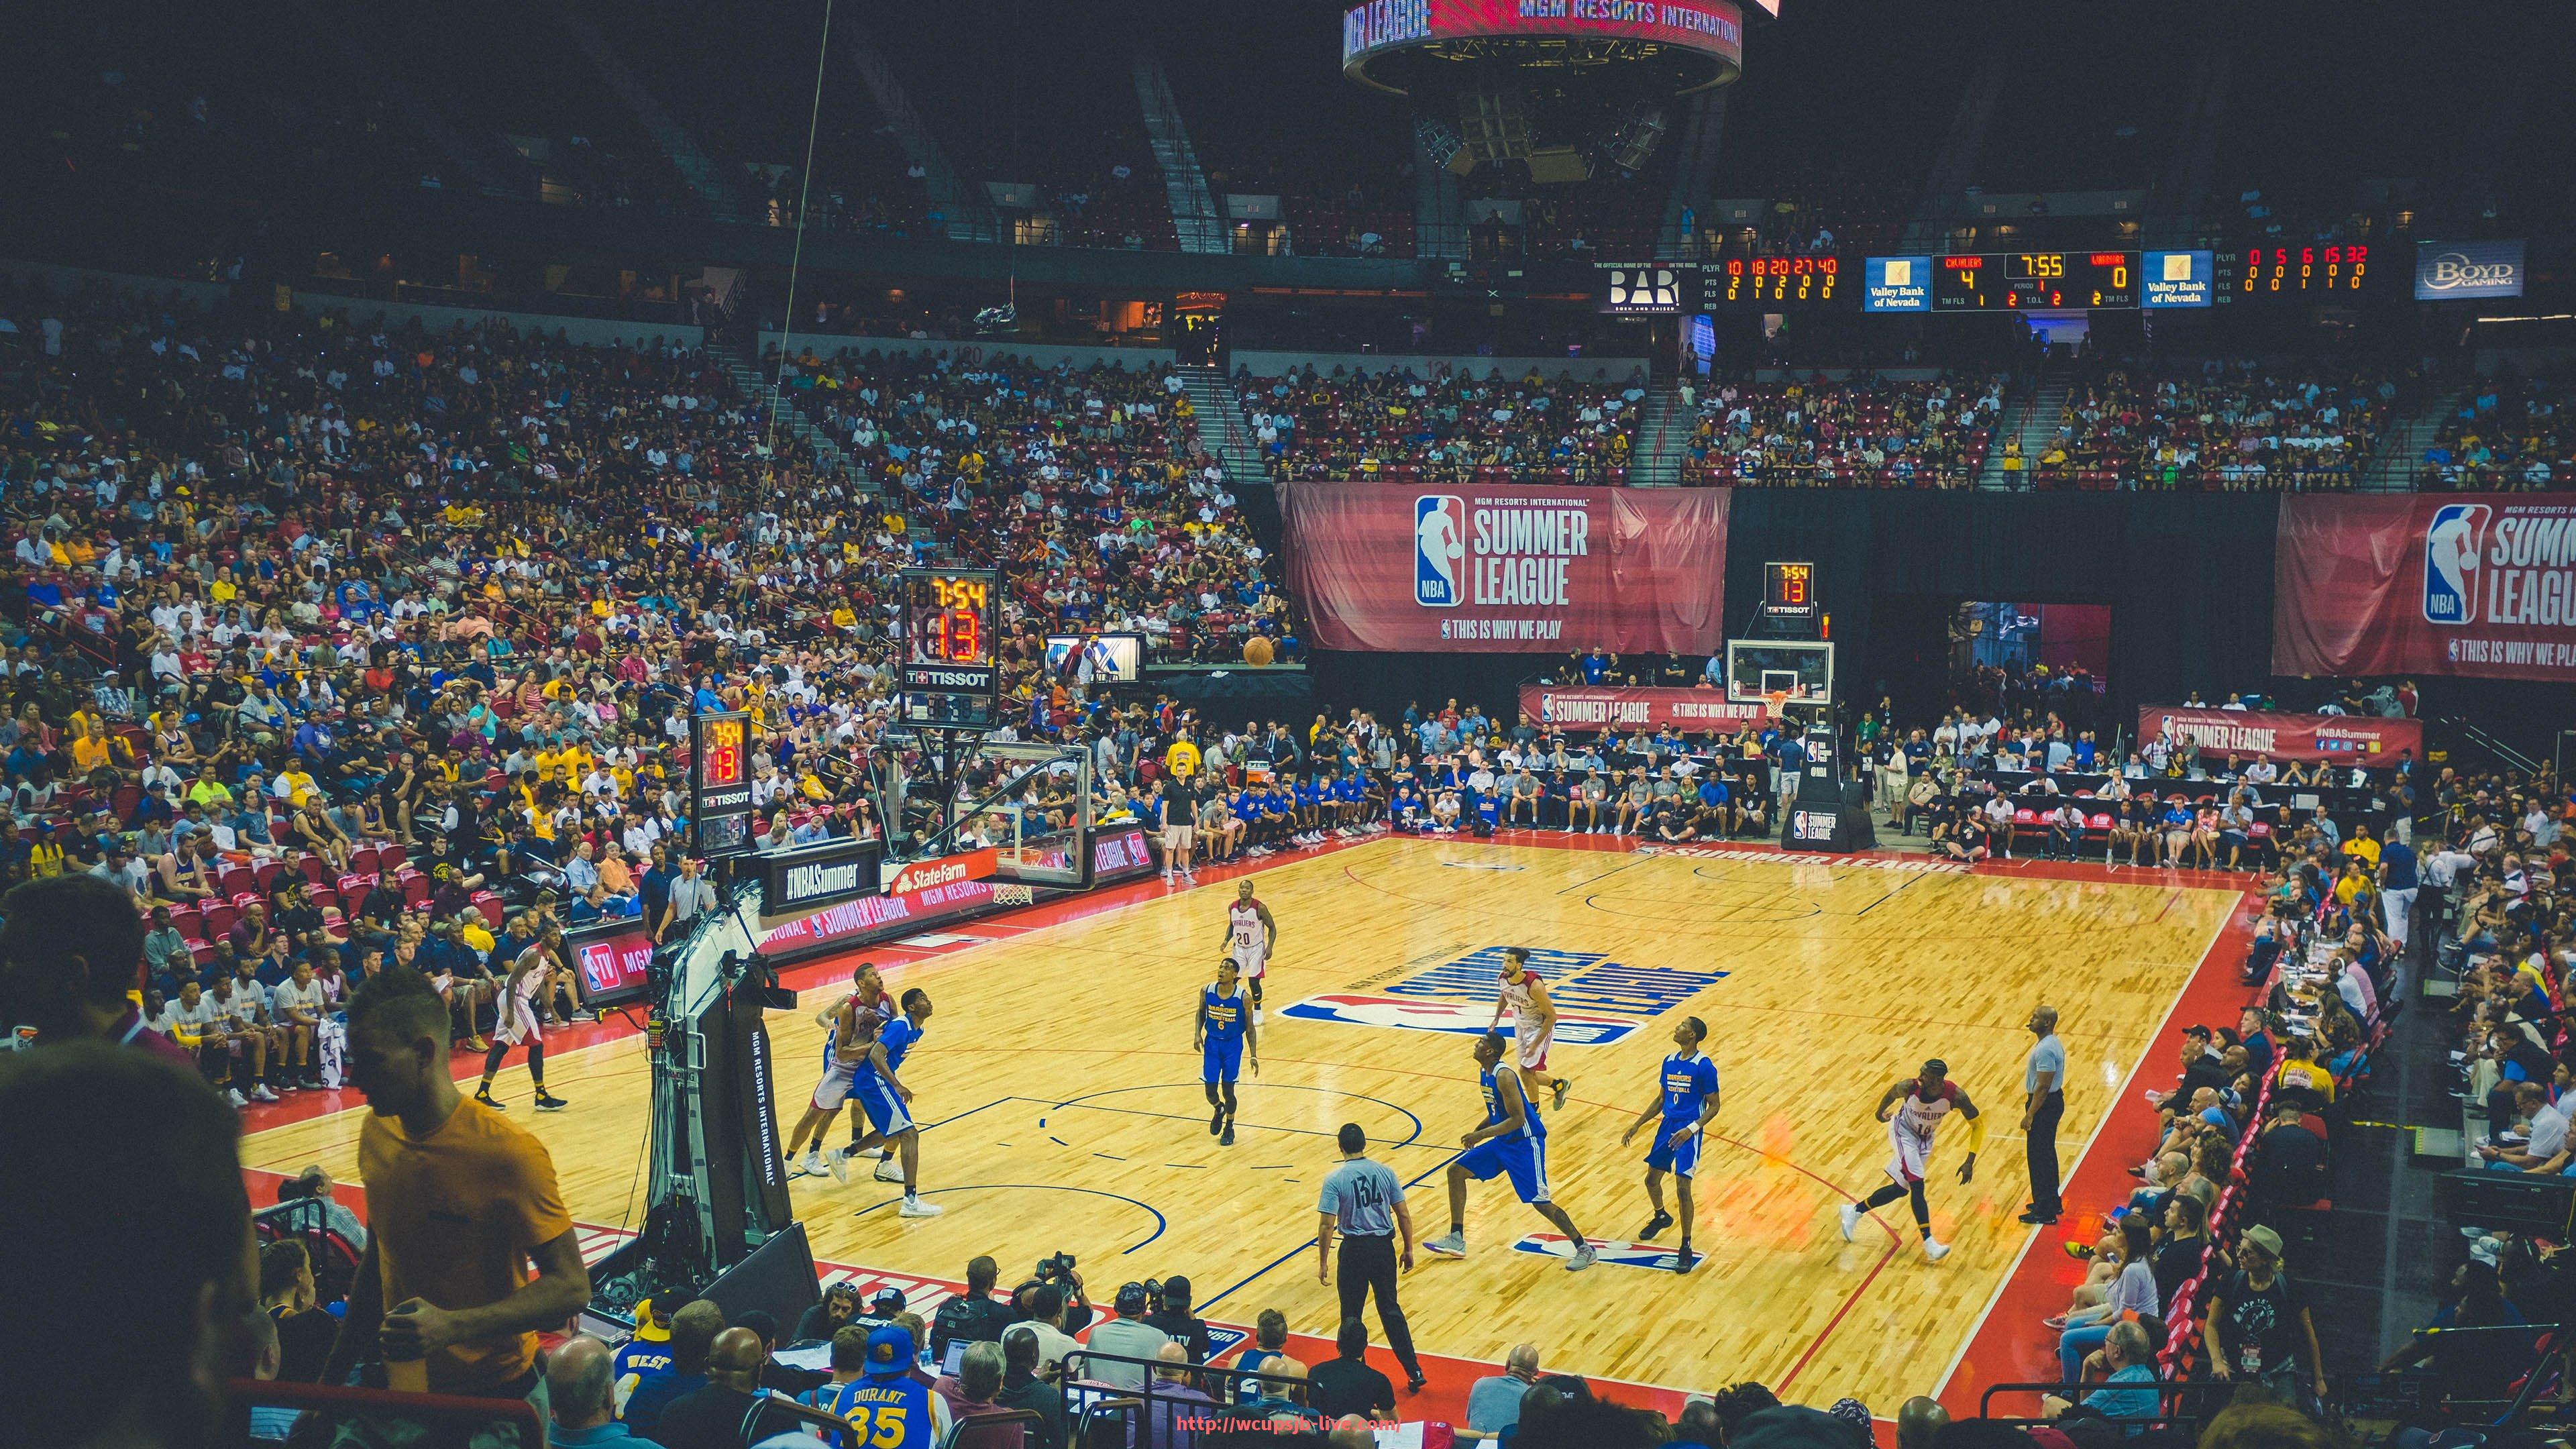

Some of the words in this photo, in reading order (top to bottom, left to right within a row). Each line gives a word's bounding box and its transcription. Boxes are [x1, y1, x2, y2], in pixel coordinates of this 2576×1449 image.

[1573, 0, 1655, 23] RESORTS
[2216, 254, 2236, 262] PLYR
[2249, 249, 2260, 265] 0
[2276, 248, 2286, 264] 5
[2302, 247, 2313, 264] 6
[2324, 246, 2340, 263] 15
[2345, 246, 2367, 262] 32
[1702, 264, 1720, 272] PLYR
[1728, 261, 1741, 275] 10
[1752, 260, 1766, 275] 18
[1770, 260, 1788, 275] 20
[1794, 259, 1813, 274] 27
[1818, 259, 1836, 274] 40
[2021, 255, 2063, 276] 7:55
[2249, 266, 2257, 278] 0
[2275, 265, 2284, 278] 0
[2302, 264, 2310, 277] 0
[2328, 264, 2337, 276] 0
[2356, 263, 2364, 276] 0
[2435, 262, 2514, 281] BOYD
[1731, 276, 1739, 288] 2
[1755, 276, 1763, 288] 0
[1778, 276, 1786, 288] 2
[1803, 275, 1811, 287] 0
[1827, 274, 1835, 287] 0
[1961, 270, 1974, 290] 4
[2039, 279, 2045, 291] 1
[2113, 266, 2127, 288] 0
[2245, 279, 2253, 291] 0
[2271, 278, 2279, 290] 0
[2351, 276, 2359, 289] 0
[2461, 277, 2513, 286] GAMING
[1728, 288, 1736, 300] 0
[1755, 288, 1759, 299] 1
[1775, 287, 1783, 300] 0
[1799, 287, 1807, 299] 0
[1823, 286, 1831, 299] 0
[1870, 287, 1898, 299] Valley
[1899, 286, 1925, 296] Bank
[2148, 282, 2178, 294] Valley
[2180, 281, 2206, 291] Bank
[1874, 298, 1884, 308] of
[1886, 297, 1920, 307] Nevada
[1980, 294, 1984, 307] 1
[2008, 292, 2017, 307] 2
[2053, 292, 2061, 306] 2
[2092, 291, 2102, 305] 2
[2151, 293, 2162, 303] of
[2165, 292, 2201, 303] Nevada
[1474, 498, 1492, 506] MGM
[1495, 498, 1527, 506] RESORTS
[2527, 506, 2568, 515] RESORTS
[1474, 508, 1588, 555] SUMMER
[1474, 557, 1570, 605] LEAGUE
[1781, 566, 1808, 580] 7:54
[932, 579, 985, 610] 7:54
[1421, 580, 1445, 598] NBA
[1784, 581, 1804, 602] 13
[2430, 594, 2455, 614] NBA
[939, 612, 978, 661] 13
[1452, 619, 1477, 639] THIS
[1479, 620, 1491, 639] IS
[1492, 620, 1517, 639] WHY
[1519, 620, 1534, 639] WE
[1536, 620, 1562, 639] PLAY
[2461, 640, 2489, 662] THIS
[2490, 641, 2504, 663] IS
[2506, 642, 2534, 664] WHY
[2536, 643, 2555, 665] WE
[928, 672, 989, 686] TISSOT
[1556, 701, 1606, 722] SUMMER
[1680, 703, 1698, 718] THIS
[1699, 704, 1707, 718] IS
[1708, 704, 1726, 718] WHY
[1726, 704, 1738, 718] WE
[1739, 704, 1758, 719] PLAY
[2231, 727, 2276, 752] LEAGUE
[2316, 727, 2380, 740] #NBASummer
[716, 749, 737, 780] 13
[1811, 767, 1827, 778] @NBA
[716, 792, 750, 806] TISSOT
[1808, 815, 1836, 828] SUMMER
[1808, 827, 1831, 841] LEAGUE
[1099, 839, 1129, 870] LEAGUE
[1667, 847, 1831, 866] SUMMER
[787, 863, 858, 900] #NBASummer
[920, 892, 945, 907] MGM
[947, 880, 987, 900] RESORTS
[823, 902, 874, 934] SUMMER
[871, 896, 910, 924] LEAGUE
[1236, 932, 1250, 945] 20
[1208, 1005, 1236, 1014] WARRIORS
[1218, 1022, 1224, 1030] 6
[752, 1031, 761, 1056] MGM
[754, 1058, 765, 1104] RESORTS
[1673, 1093, 1678, 1104] 0
[1351, 1174, 1383, 1209] 134
[1177, 1335, 1191, 1346] TV
[627, 1353, 670, 1372] WEST
[853, 1388, 907, 1404] DURANT
[841, 1406, 907, 1449] 35
